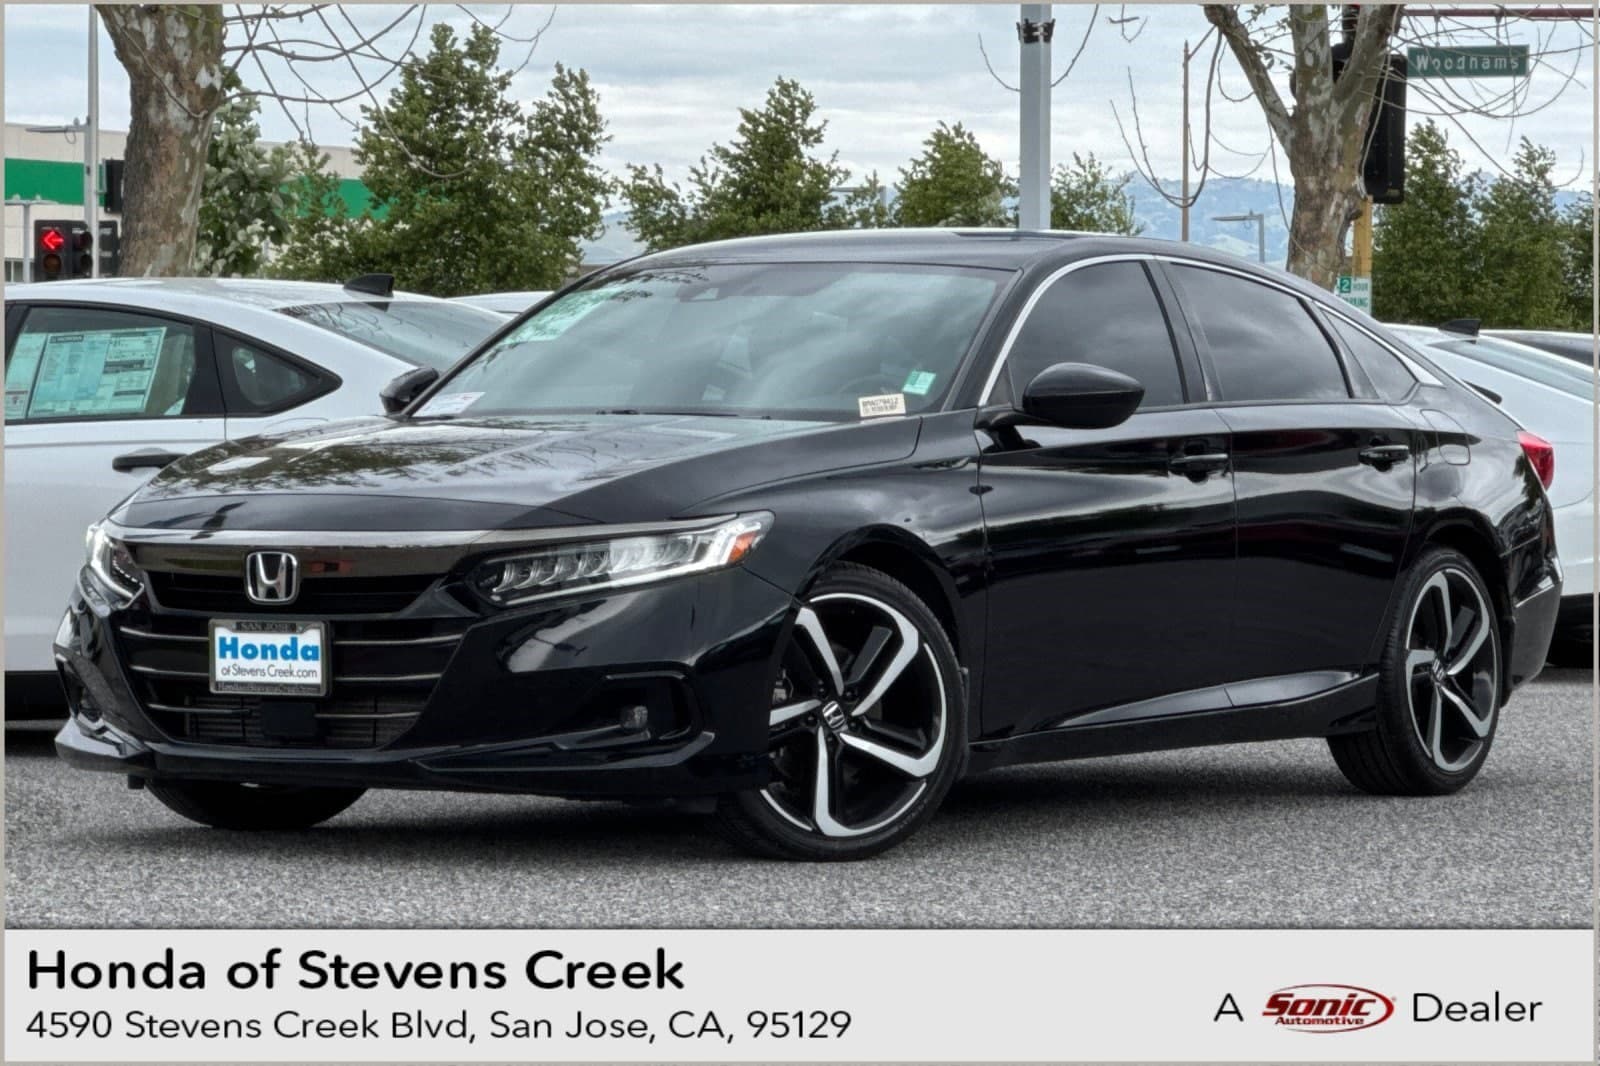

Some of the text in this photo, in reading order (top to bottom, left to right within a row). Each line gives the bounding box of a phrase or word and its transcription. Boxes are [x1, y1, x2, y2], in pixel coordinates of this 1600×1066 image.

[1416, 54, 1520, 71] Woodhams
[1342, 279, 1350, 291] 2
[240, 622, 263, 632] SAN
[218, 636, 320, 662] Honda
[221, 663, 318, 679] of Stevens Creek.com
